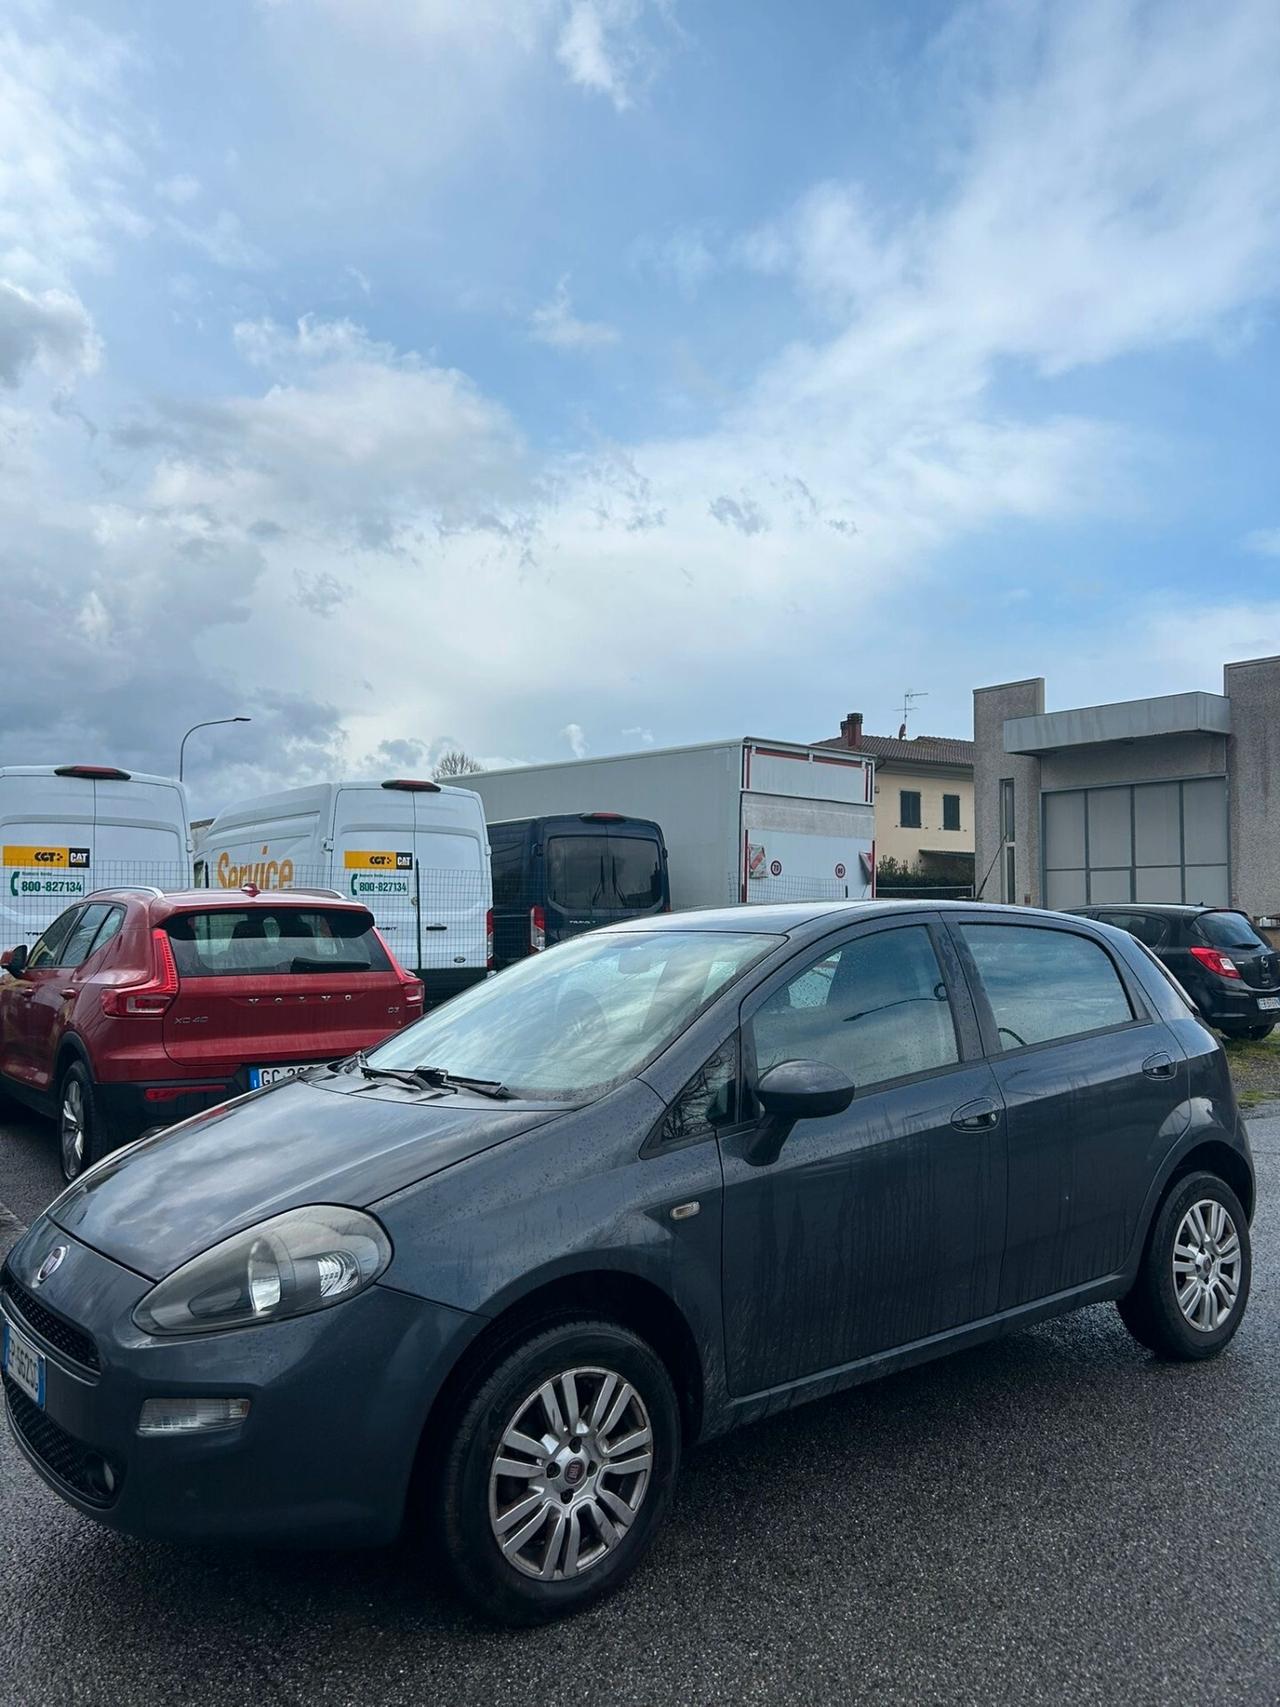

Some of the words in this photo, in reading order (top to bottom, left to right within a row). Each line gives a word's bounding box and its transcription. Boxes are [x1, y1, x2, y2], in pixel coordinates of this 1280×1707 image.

[70, 852, 88, 863] CAT
[397, 856, 411, 866] CAT
[217, 845, 294, 889] Service
[21, 880, 82, 892] 800-827134
[359, 881, 407, 892] 800-827134
[248, 994, 352, 1004] VOLVO
